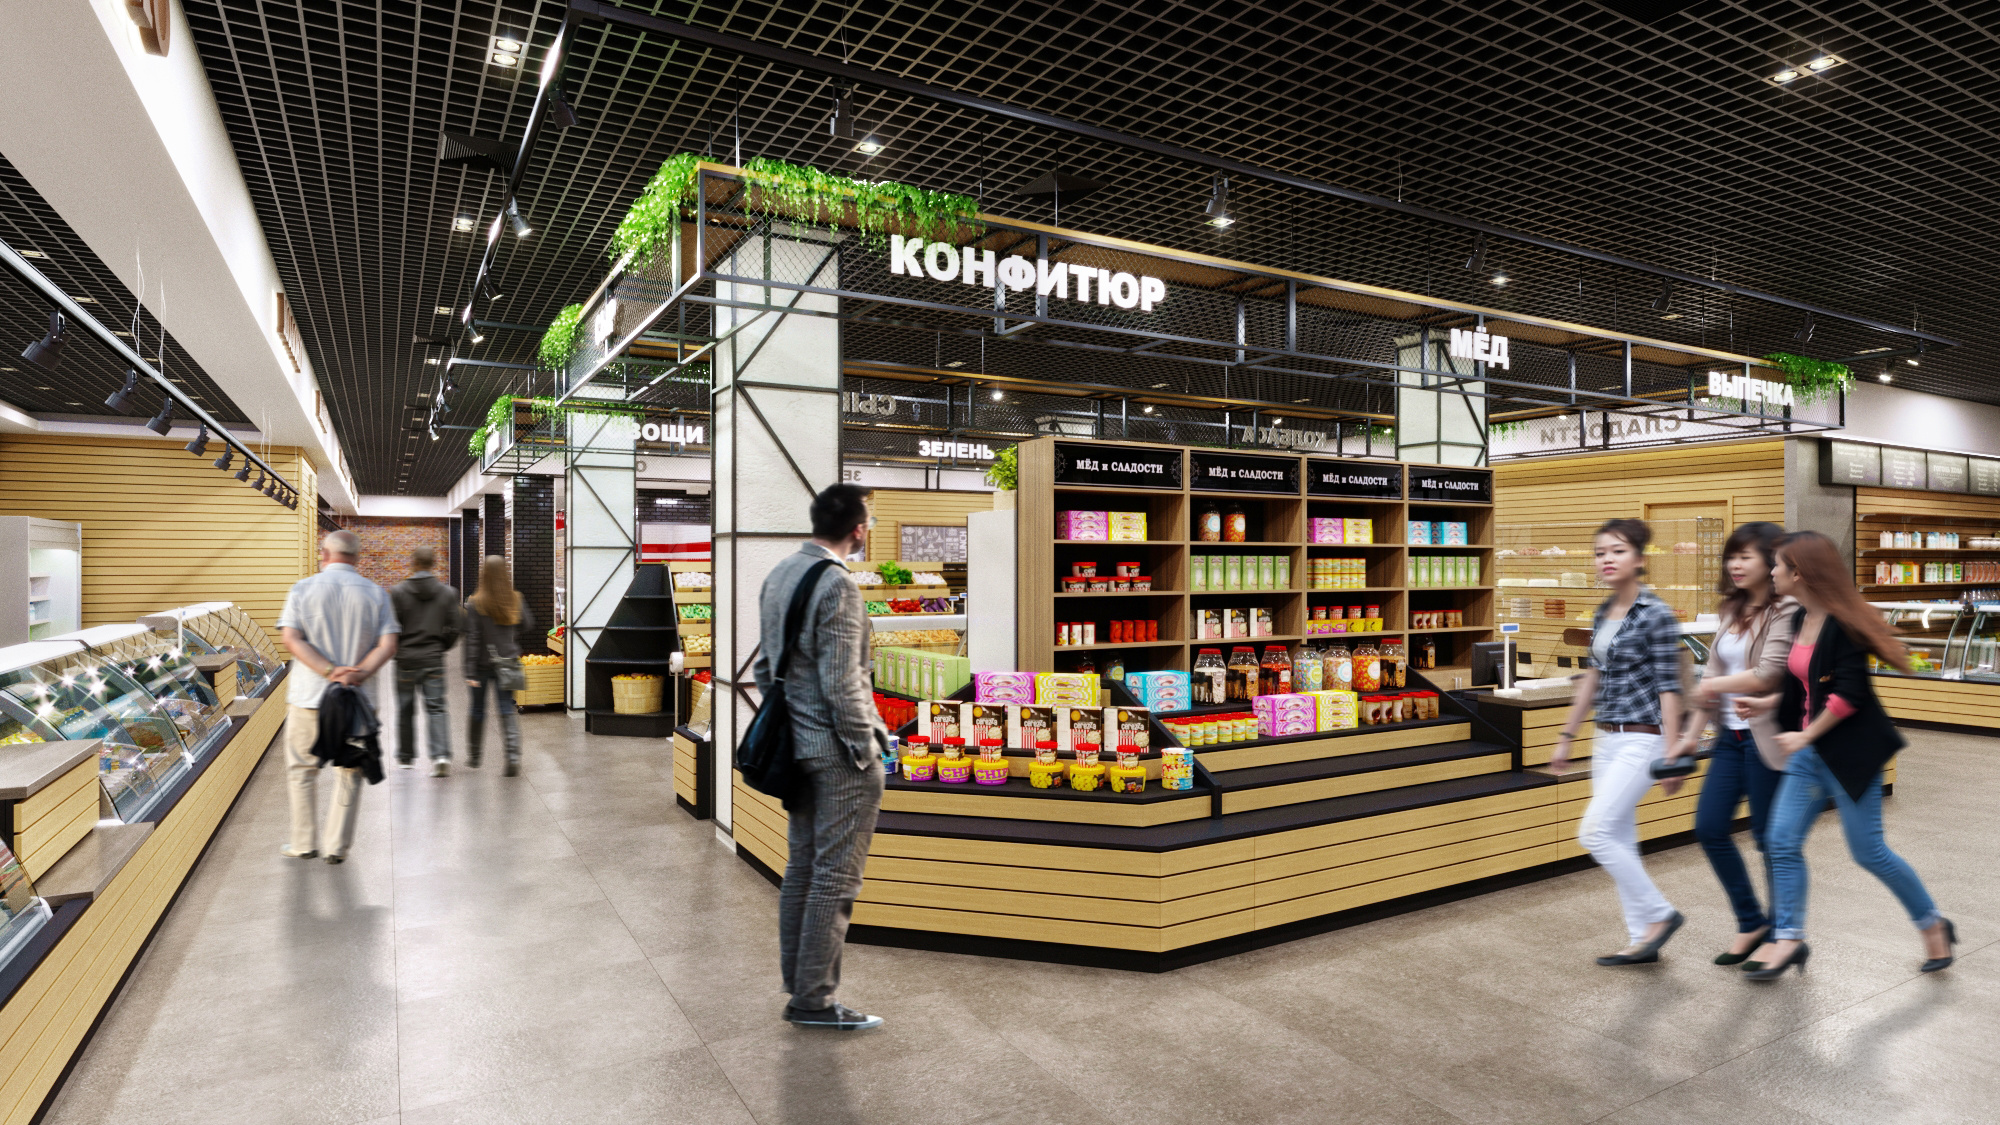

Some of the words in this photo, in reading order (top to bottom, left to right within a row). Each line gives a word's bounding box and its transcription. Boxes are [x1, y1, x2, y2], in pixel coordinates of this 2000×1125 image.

[890, 234, 1166, 312] КОНФИТЮР
[1450, 325, 1510, 370] МЁД
[1708, 371, 1795, 407] ВЫПЕЧКА
[918, 440, 995, 460] ЗЕЛЕНЬ
[1076, 459, 1099, 471] МЁД
[1111, 462, 1163, 474] СЛАДОСТИ
[1208, 467, 1229, 479] МЁД
[1239, 469, 1283, 480] СЛАДОСТИ
[1322, 473, 1339, 484] МЁД
[1348, 475, 1388, 486] СЛАДОСТИ
[1421, 479, 1437, 489] МЁД
[1444, 481, 1479, 491] СЛАДОСТИ
